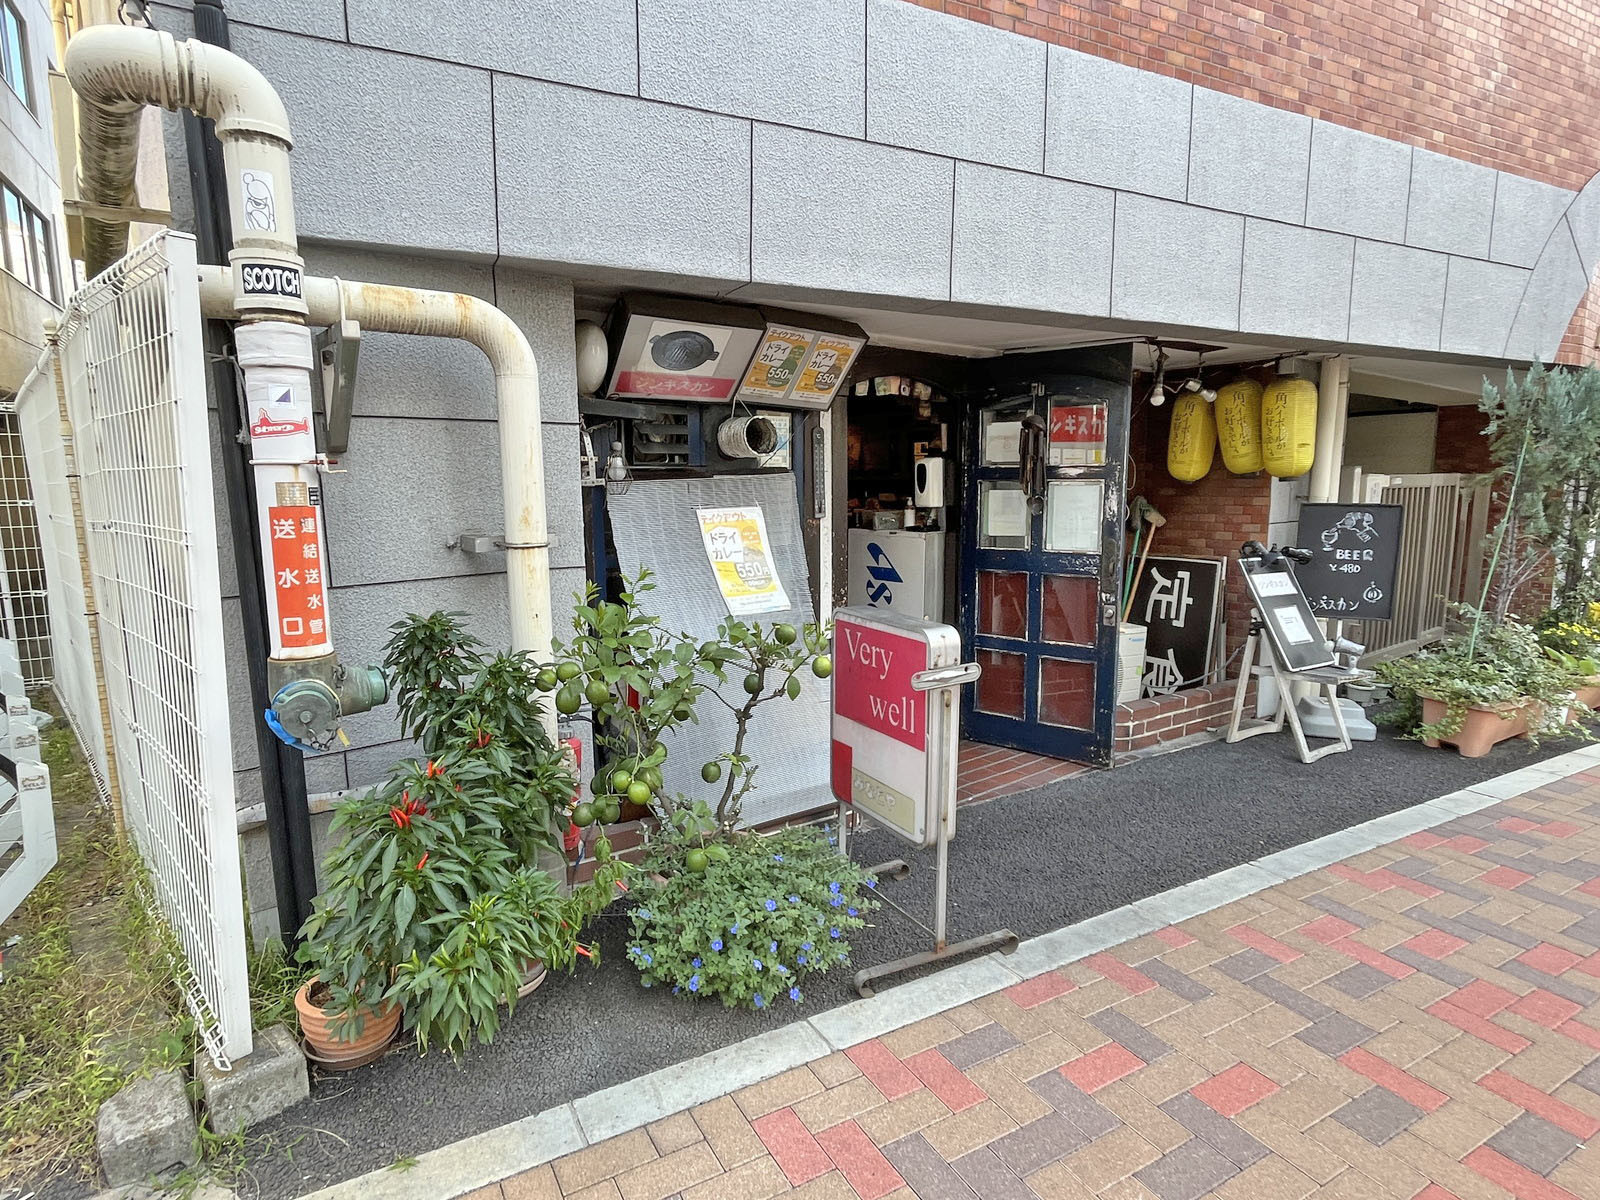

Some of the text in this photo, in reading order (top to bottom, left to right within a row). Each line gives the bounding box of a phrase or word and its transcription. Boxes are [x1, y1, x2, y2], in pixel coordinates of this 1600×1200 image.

[243, 267, 301, 295] SCOTCH
[769, 329, 806, 341] テイクアウト
[766, 343, 790, 354] ドライ
[759, 353, 784, 363] カレー
[815, 351, 836, 361] ドライ
[809, 360, 831, 369] カレー
[701, 511, 746, 524] テイクアウト
[710, 531, 736, 545] ドライ
[712, 546, 742, 560] カレー
[1336, 549, 1374, 561] BEER
[273, 518, 304, 636] 送水口
[300, 517, 325, 635] 連結送水管
[1141, 566, 1194, 698] 定食
[844, 628, 893, 680] Very
[869, 695, 915, 735] well
